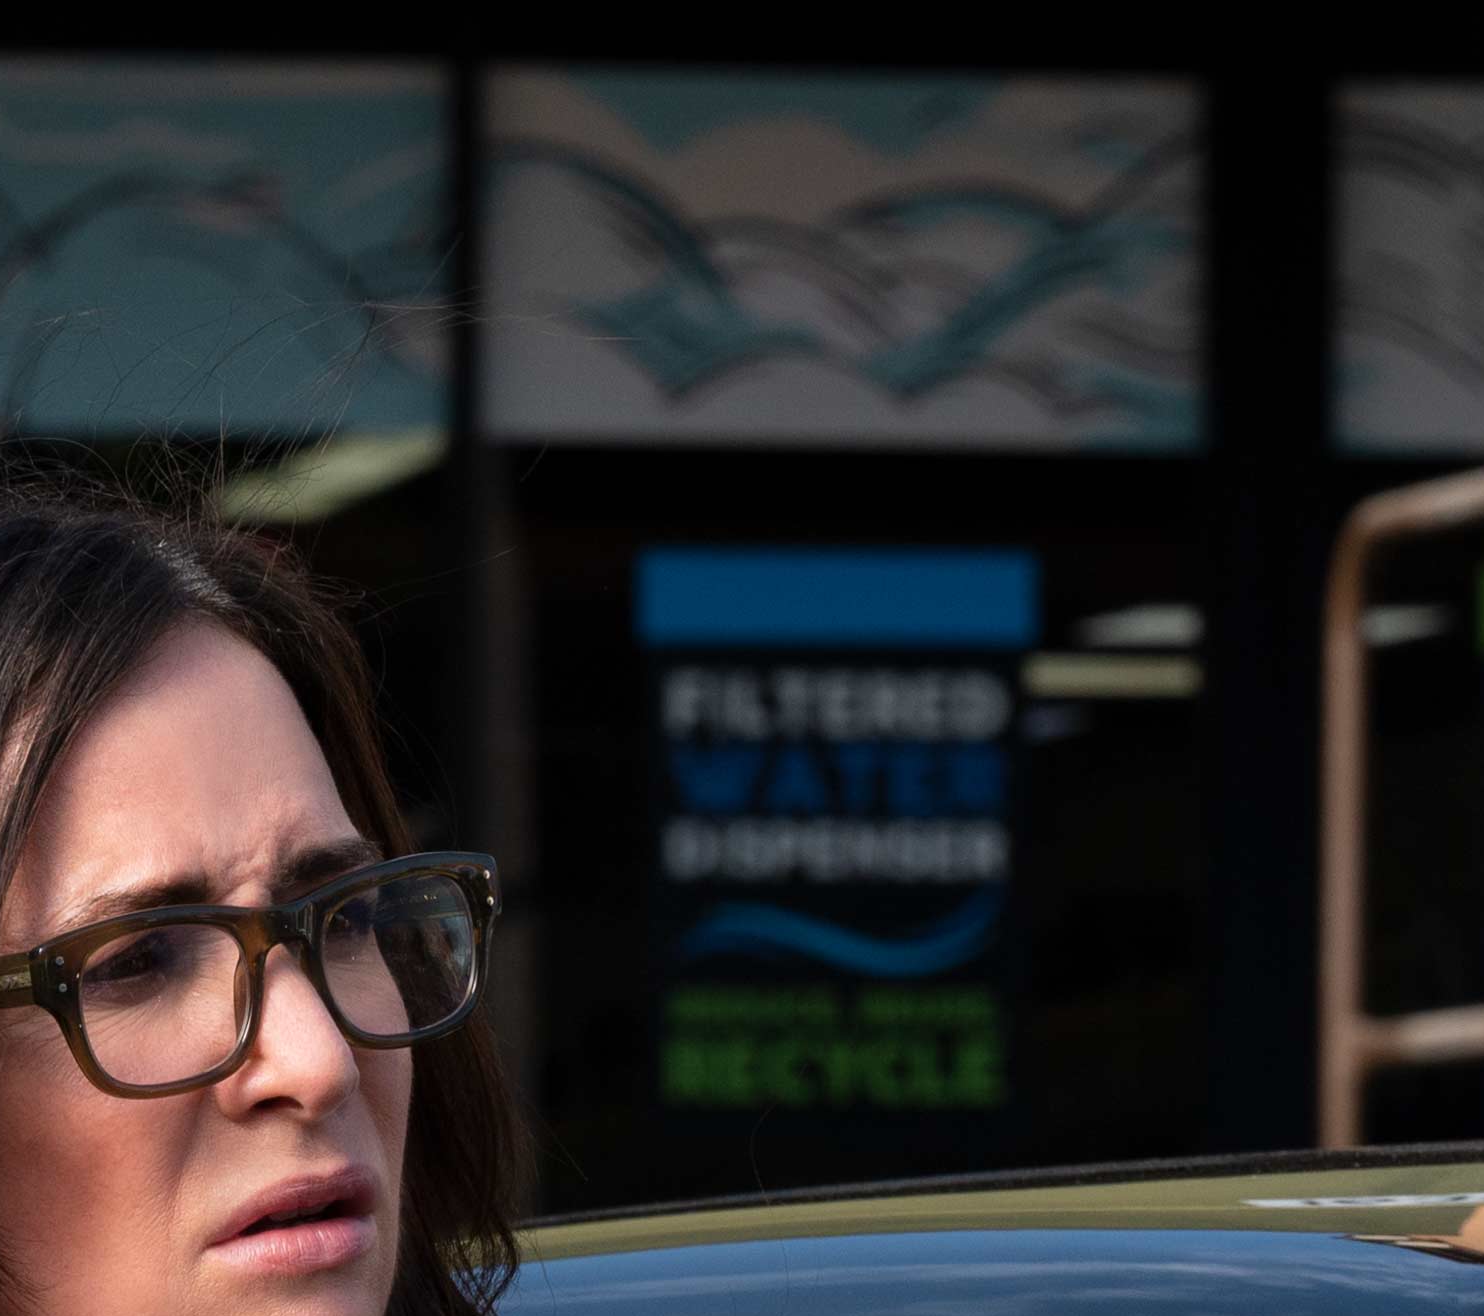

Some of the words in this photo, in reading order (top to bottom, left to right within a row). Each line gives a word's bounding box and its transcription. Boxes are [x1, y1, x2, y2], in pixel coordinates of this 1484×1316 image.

[665, 673, 1005, 736] FILTERED
[667, 743, 1005, 813] WATER
[666, 1037, 1004, 1100] RECYCLE
